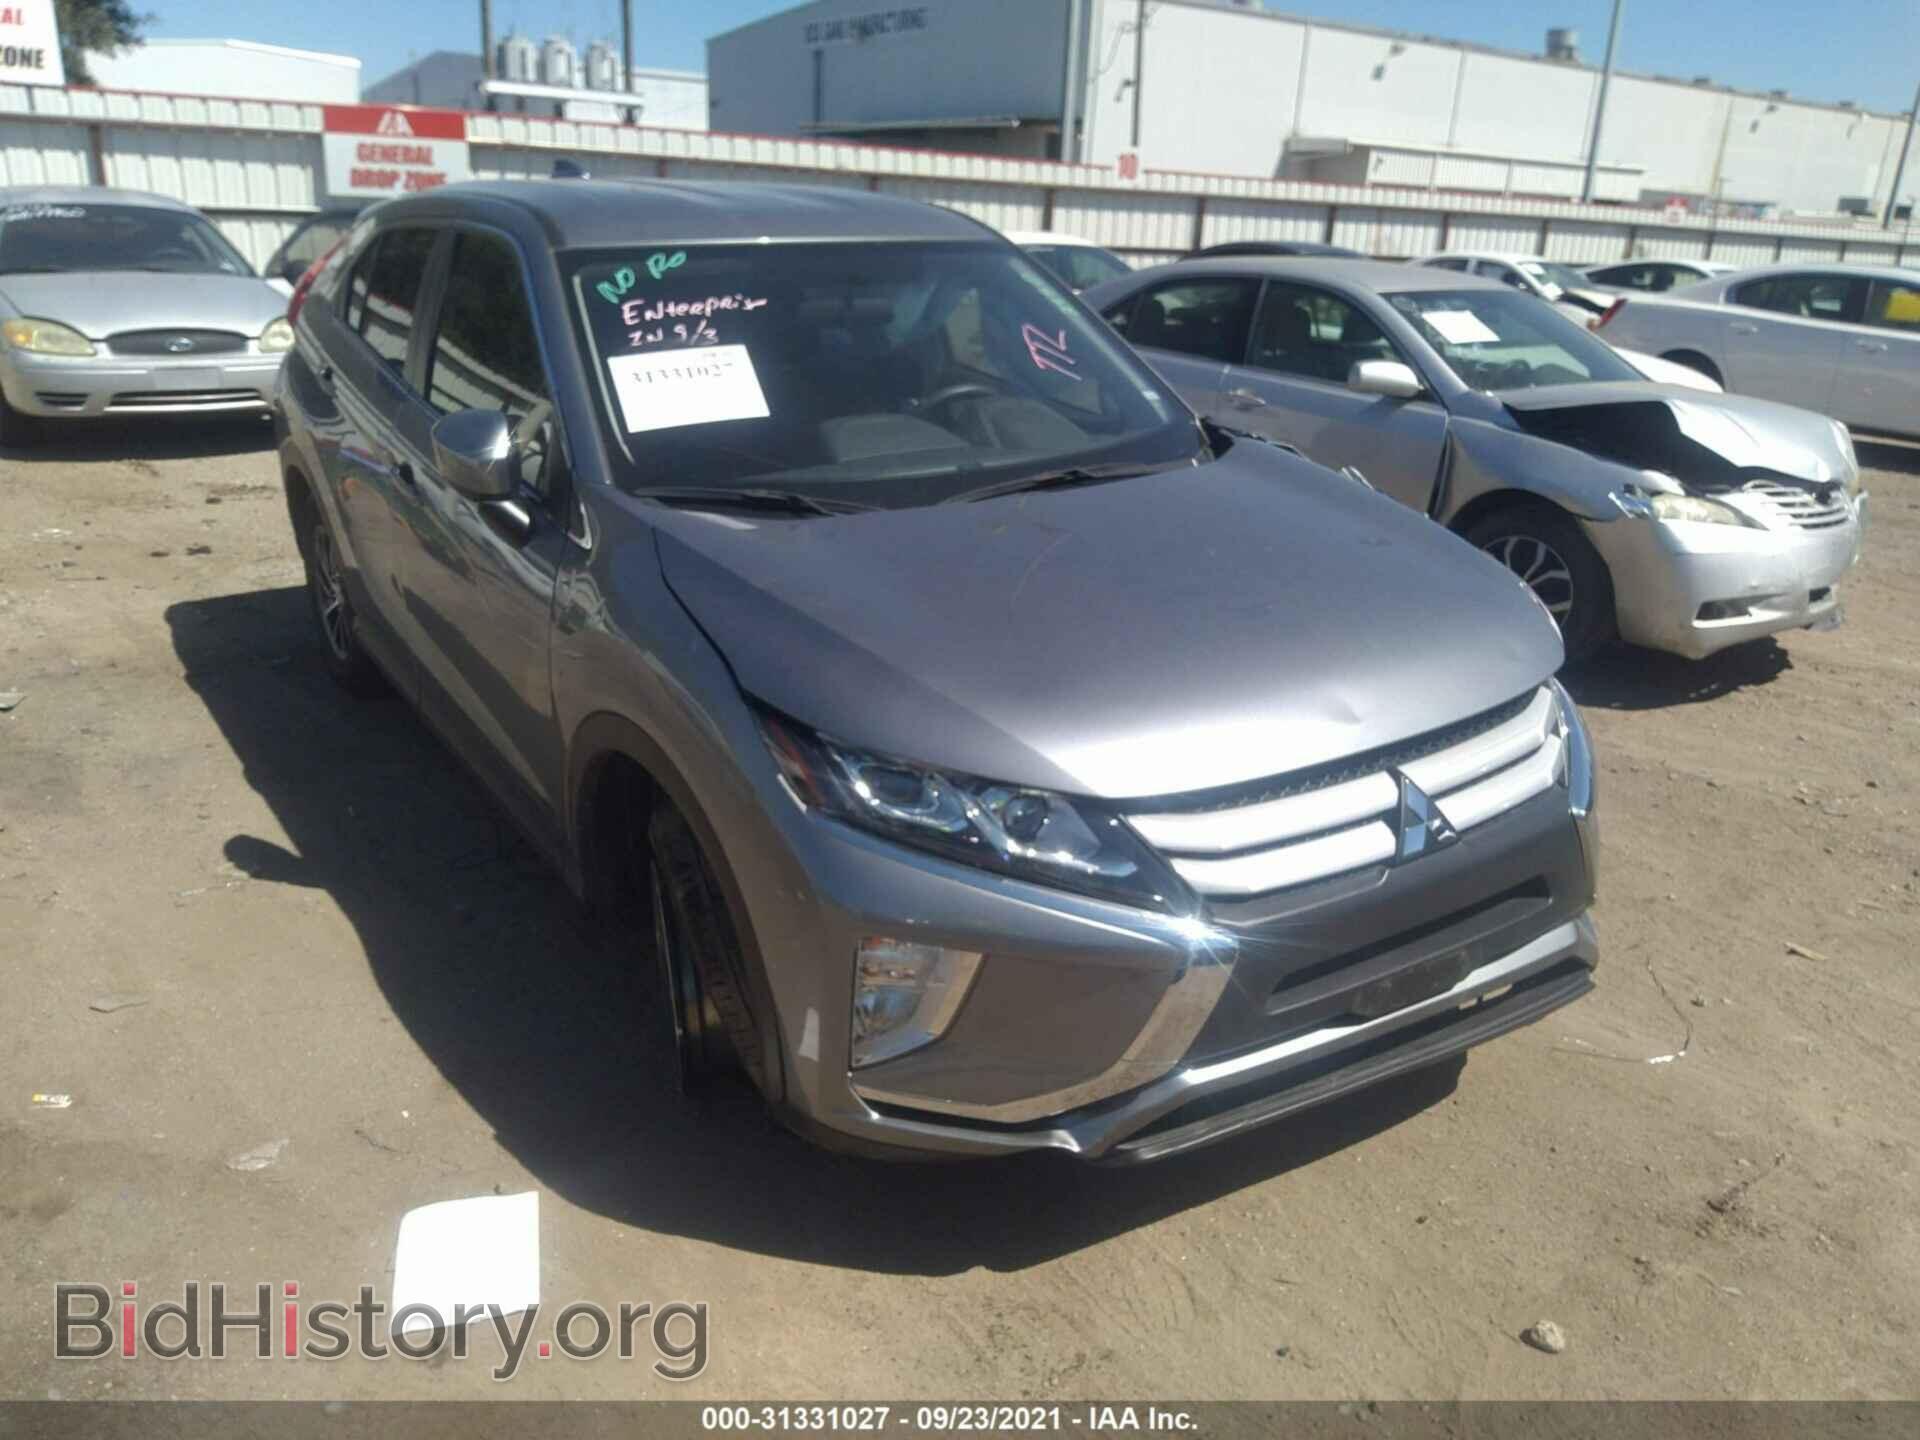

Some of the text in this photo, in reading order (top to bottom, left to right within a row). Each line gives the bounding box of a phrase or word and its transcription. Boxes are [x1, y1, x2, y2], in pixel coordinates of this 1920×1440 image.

[356, 142, 434, 165] GENERAL
[350, 168, 400, 188] DROP
[596, 266, 636, 304] NO
